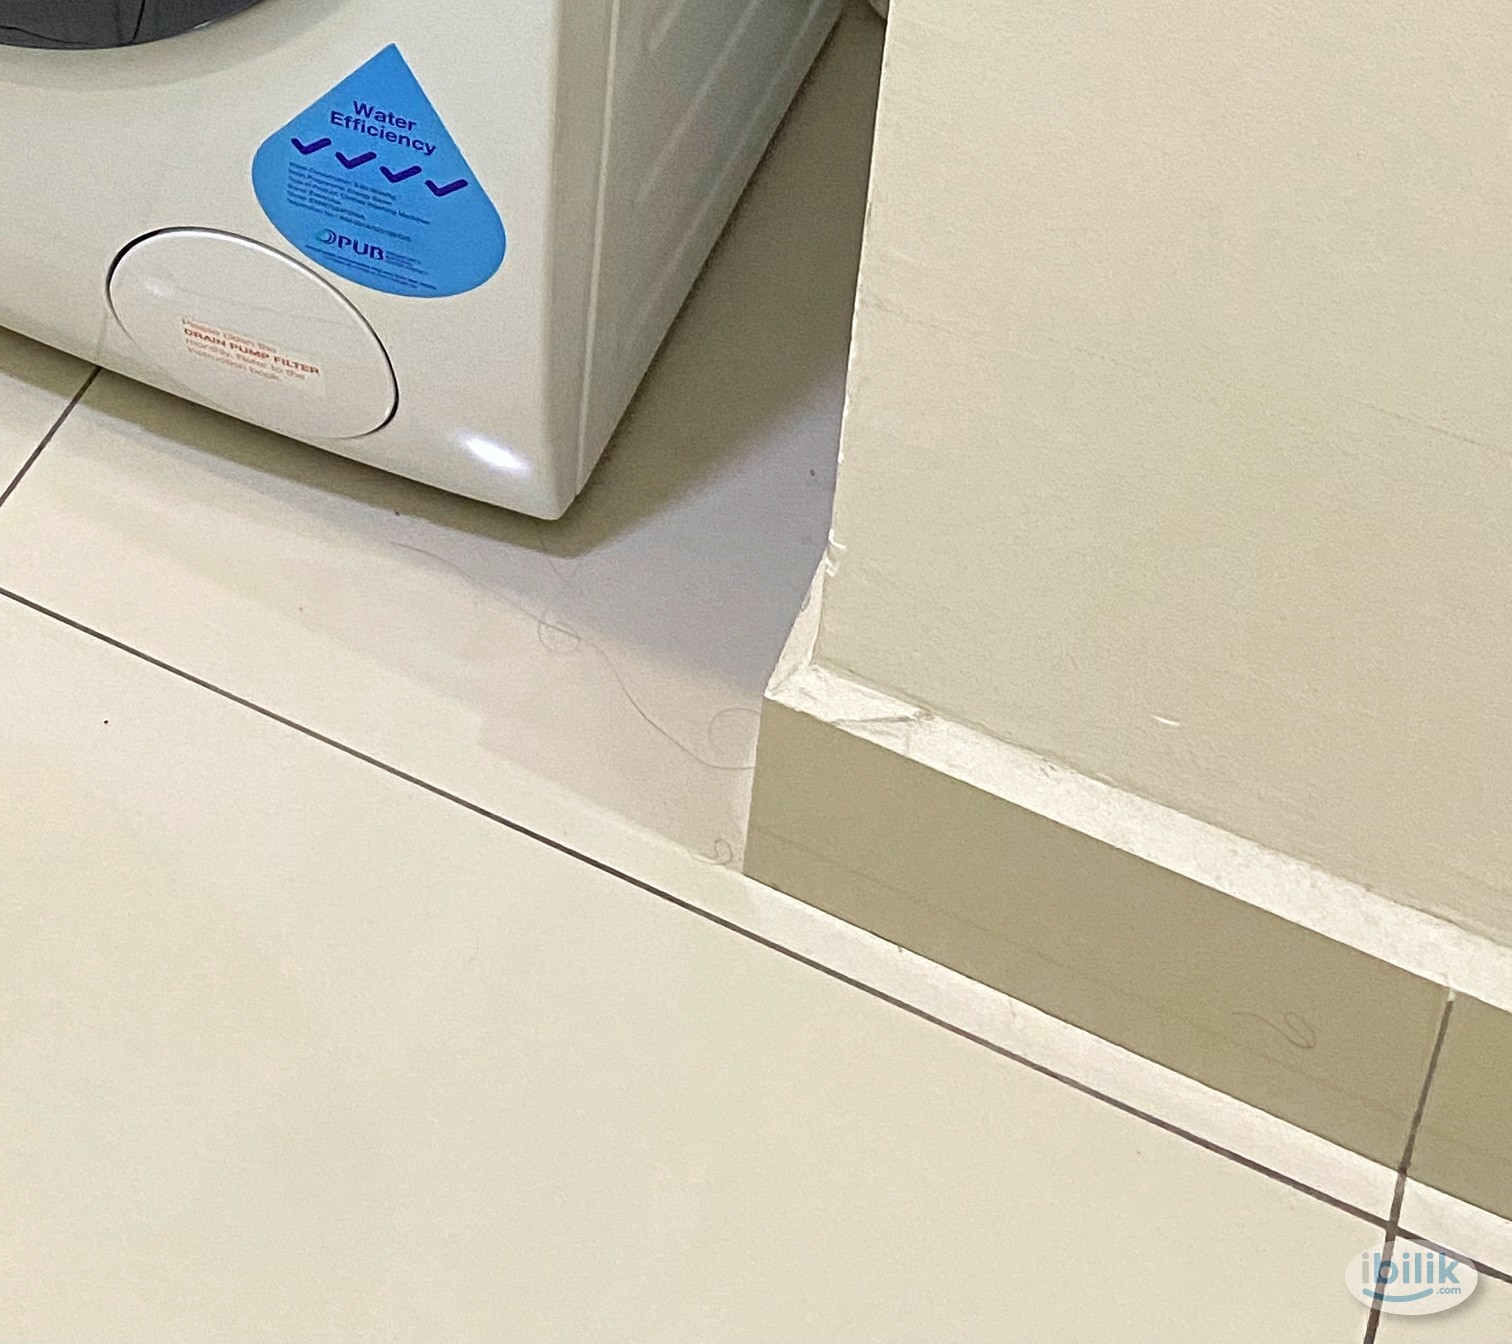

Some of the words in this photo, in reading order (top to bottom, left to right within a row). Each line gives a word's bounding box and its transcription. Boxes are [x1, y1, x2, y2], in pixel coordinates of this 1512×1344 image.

[330, 110, 436, 156] Efficiency
[353, 100, 417, 132] Water
[338, 234, 384, 260] PUB
[184, 328, 226, 347] DRAIN
[229, 342, 270, 359] PUMP
[273, 355, 320, 374] FILTER
